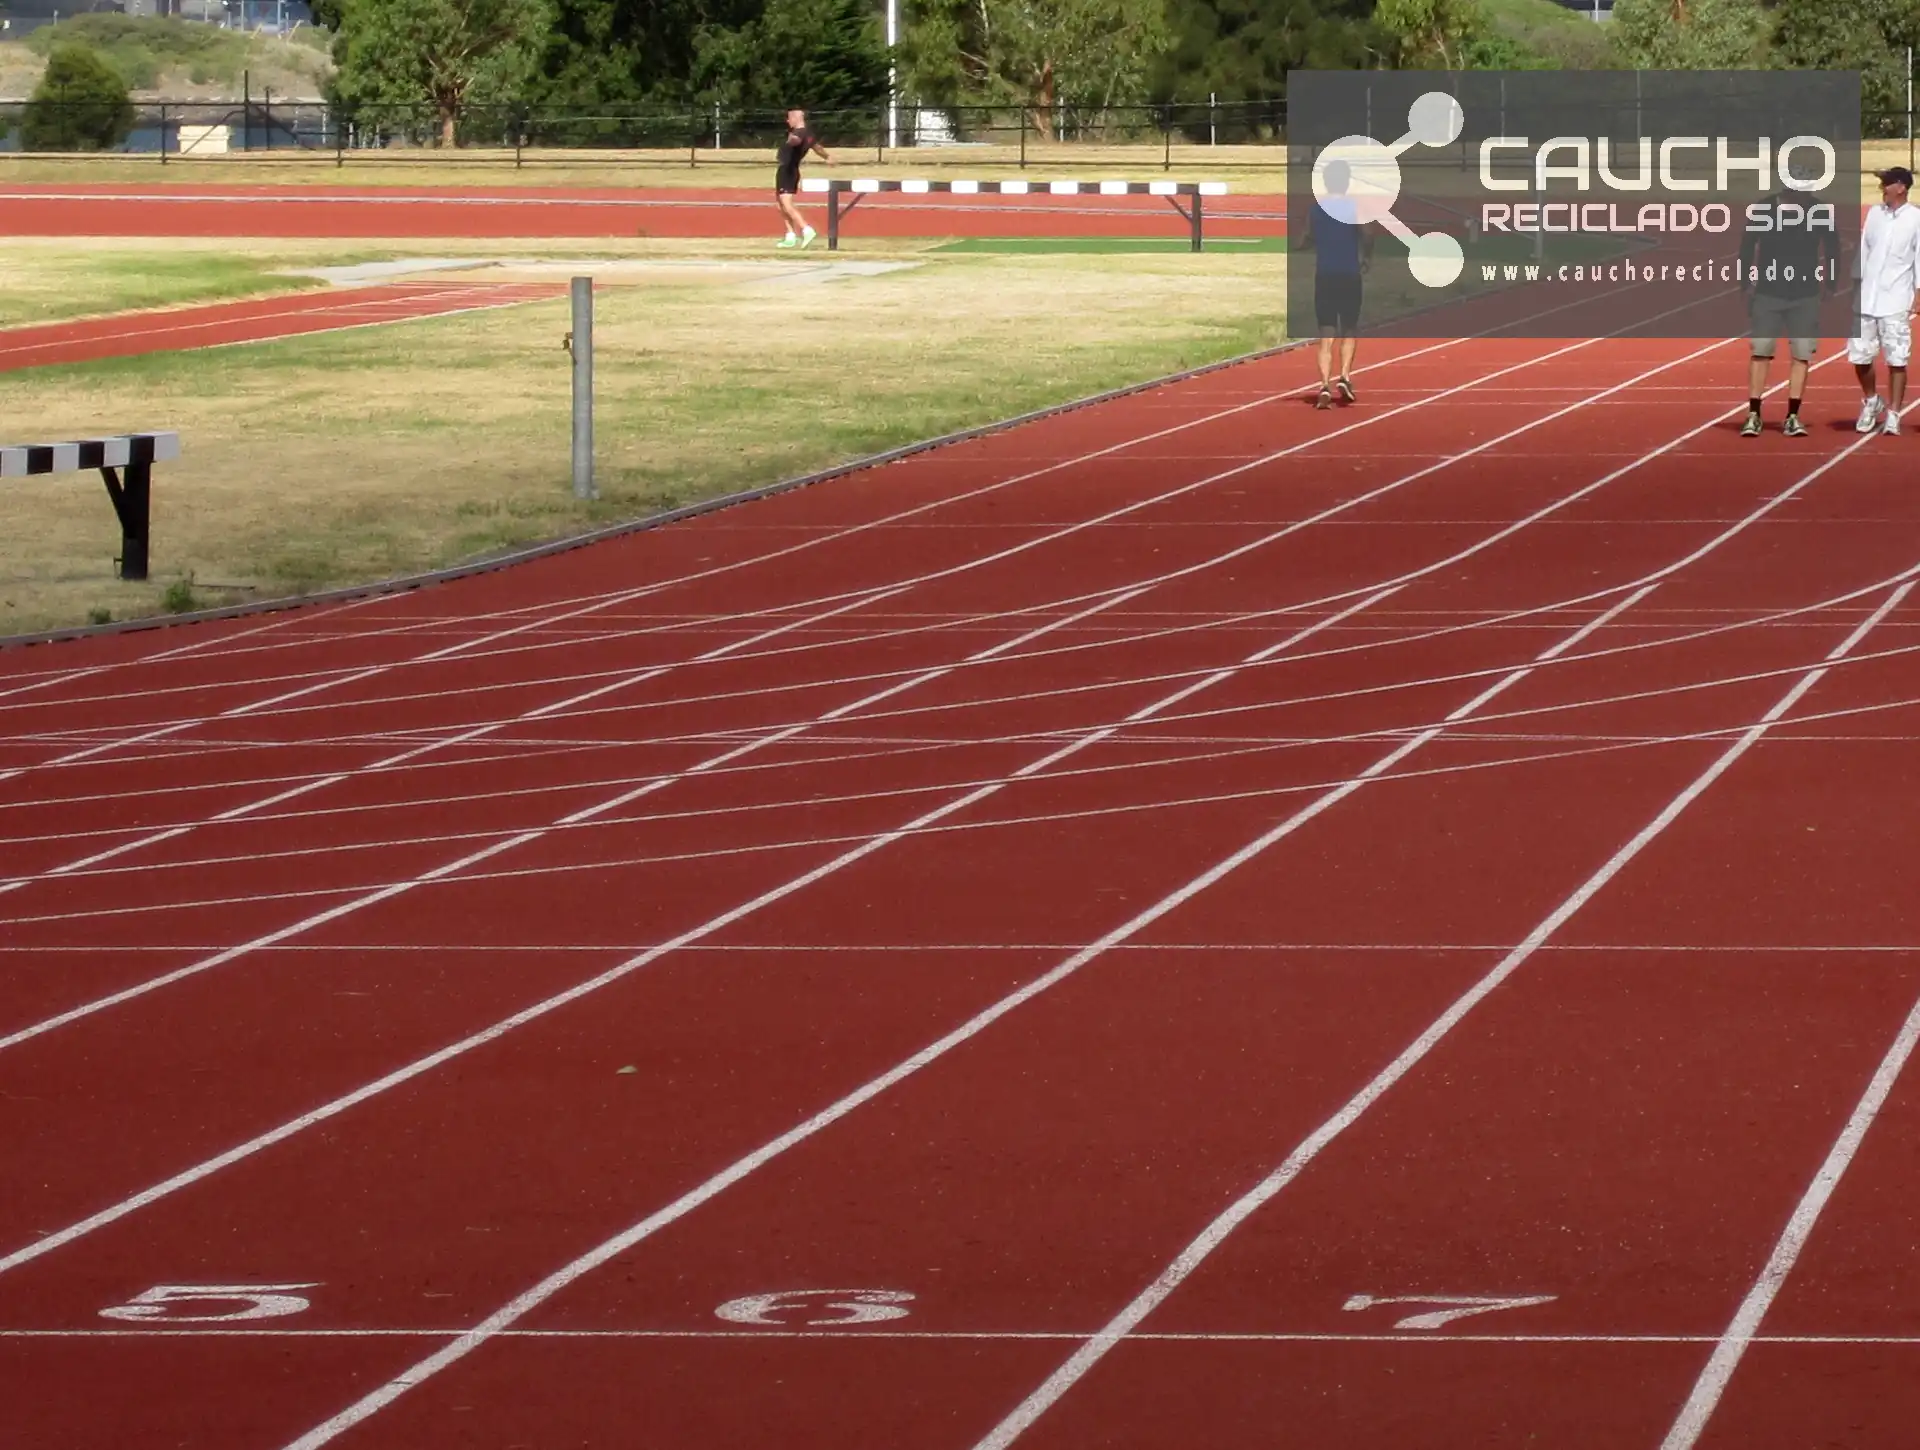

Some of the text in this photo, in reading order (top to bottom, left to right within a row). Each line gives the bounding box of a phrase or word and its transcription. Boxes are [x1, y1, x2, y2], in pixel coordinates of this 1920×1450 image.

[98, 1282, 326, 1322] 5
[714, 1289, 915, 1325] 6
[1341, 1295, 1558, 1329] 7
